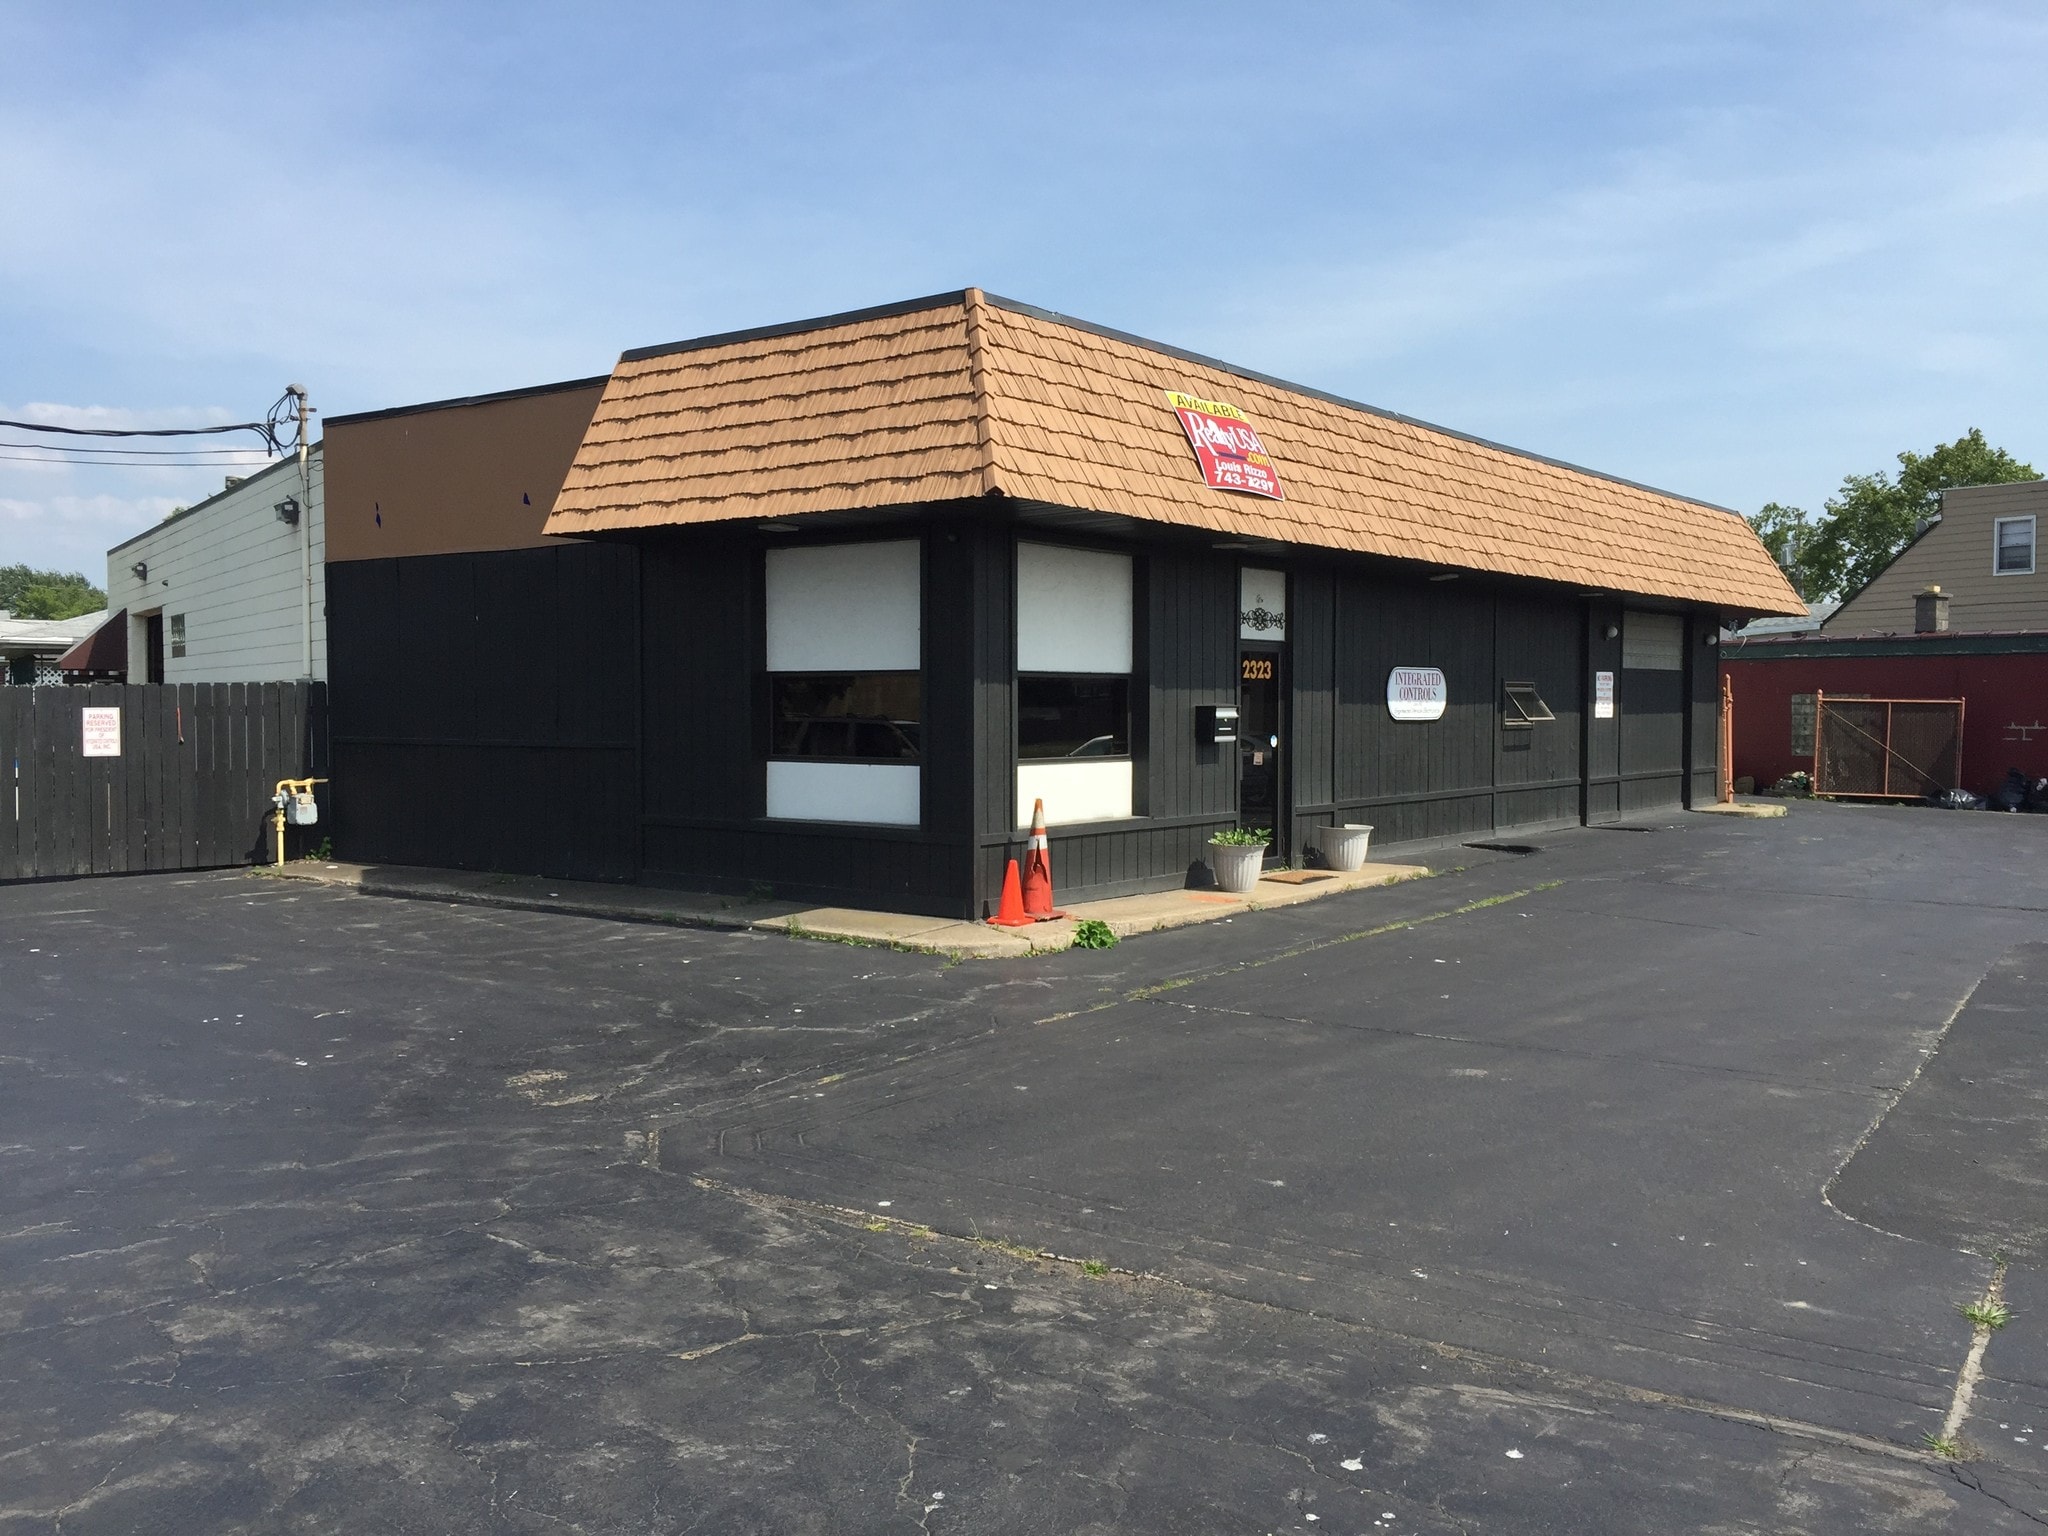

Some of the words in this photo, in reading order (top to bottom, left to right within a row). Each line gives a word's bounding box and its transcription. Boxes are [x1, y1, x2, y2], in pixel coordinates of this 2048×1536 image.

[1177, 395, 1245, 420] AVAILABLE
[1215, 459, 1242, 473] Louis
[1243, 464, 1268, 479] Rizzo
[1242, 660, 1272, 680] 2323
[1395, 672, 1441, 686] INTEGRATED
[1399, 687, 1437, 701] CONTROLS
